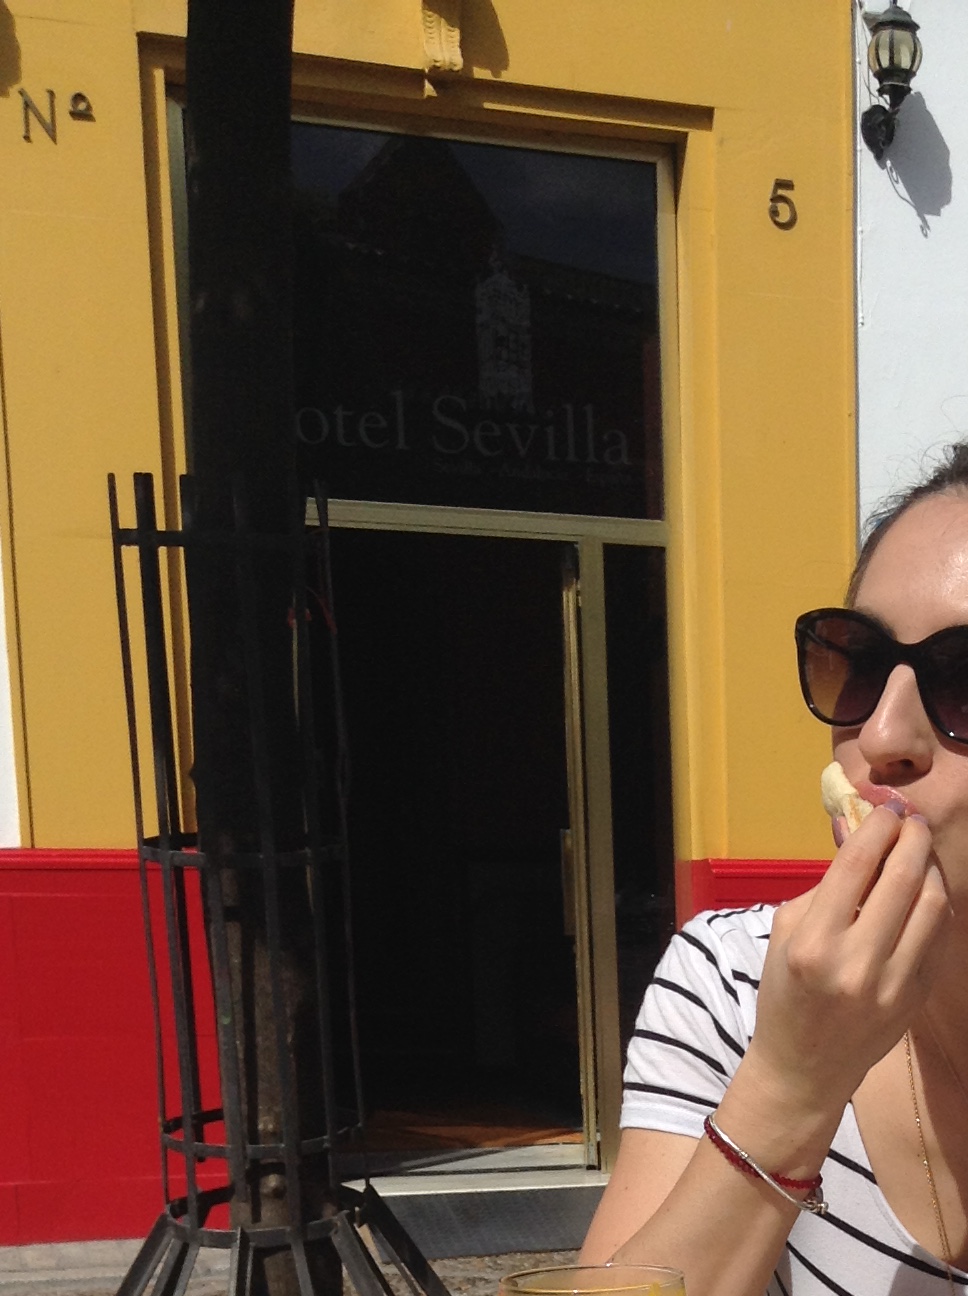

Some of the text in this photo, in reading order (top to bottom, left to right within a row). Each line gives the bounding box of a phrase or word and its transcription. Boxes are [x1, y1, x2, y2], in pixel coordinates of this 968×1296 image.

[768, 178, 798, 231] 5
[294, 389, 633, 467] otel Sevilla
